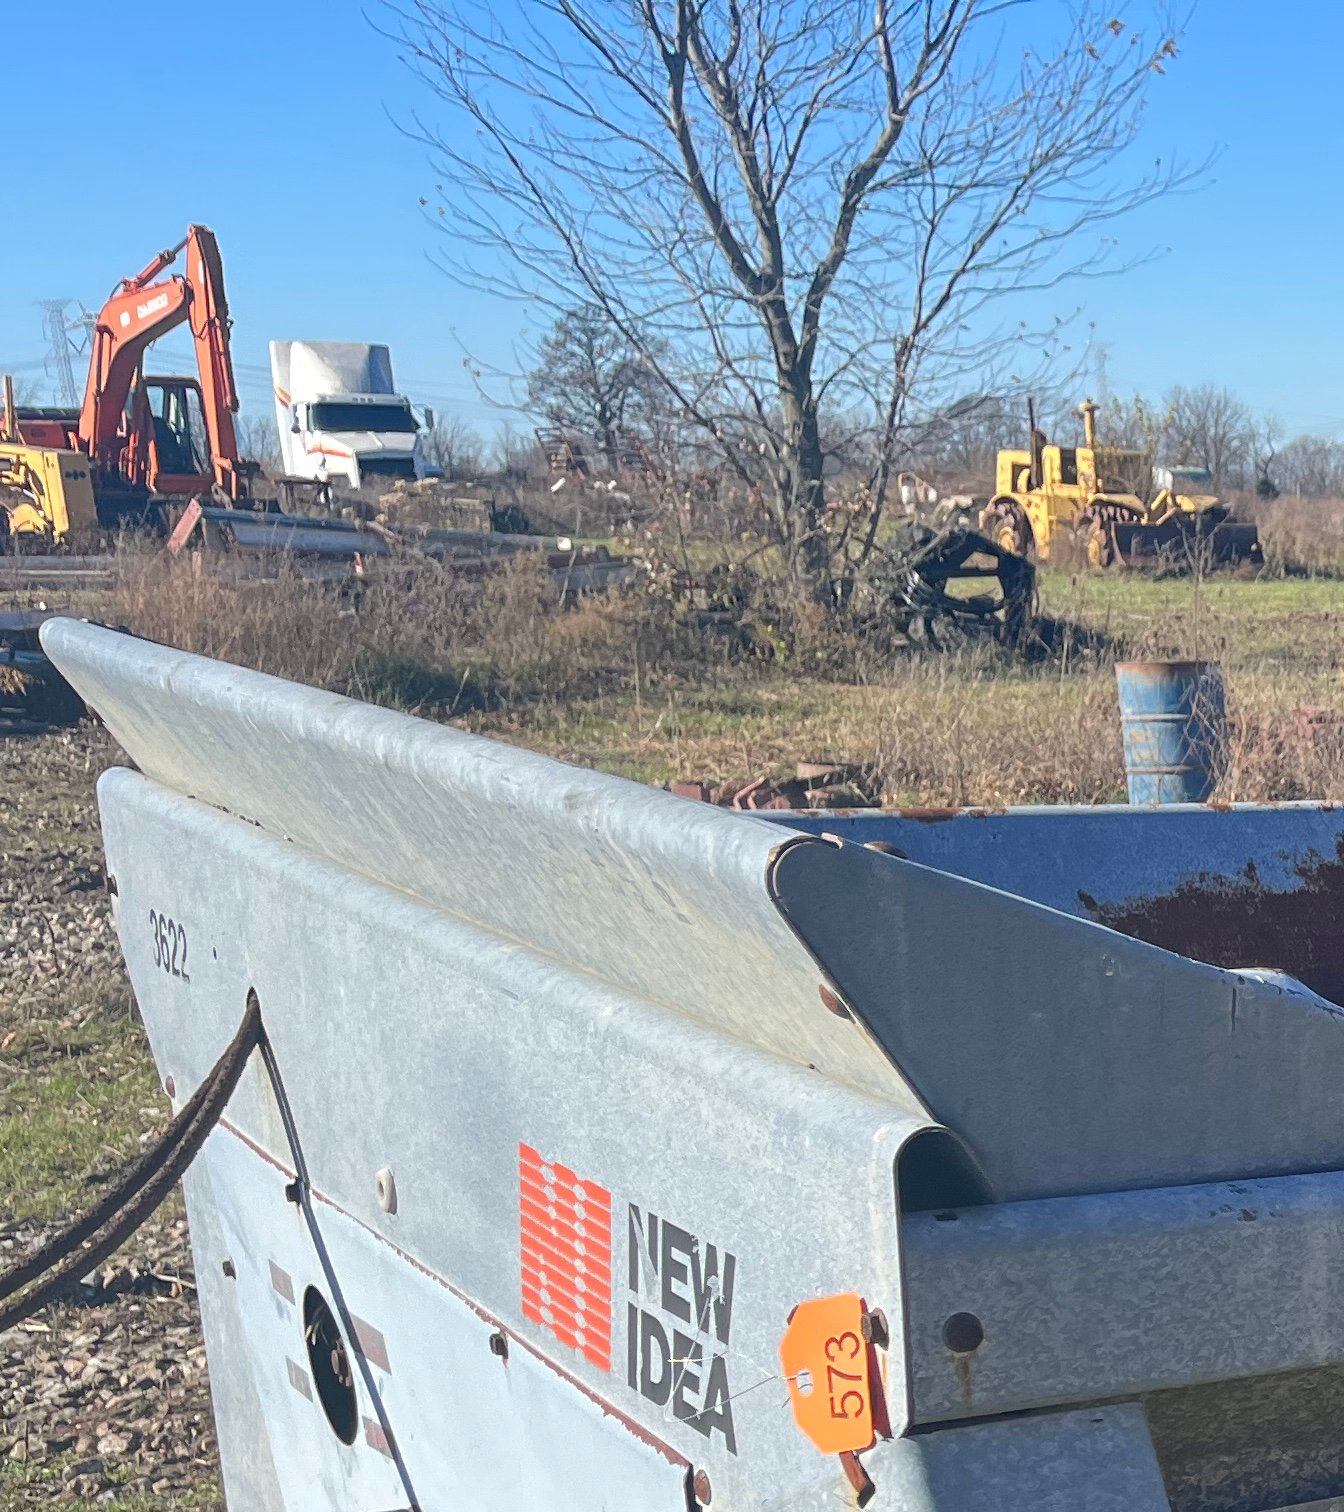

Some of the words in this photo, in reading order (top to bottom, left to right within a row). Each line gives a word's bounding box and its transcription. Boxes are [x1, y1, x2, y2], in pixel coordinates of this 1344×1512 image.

[149, 908, 190, 984] 3622
[627, 1201, 737, 1346] NEW
[627, 1301, 738, 1457] IDEA
[824, 1331, 865, 1421] 573
